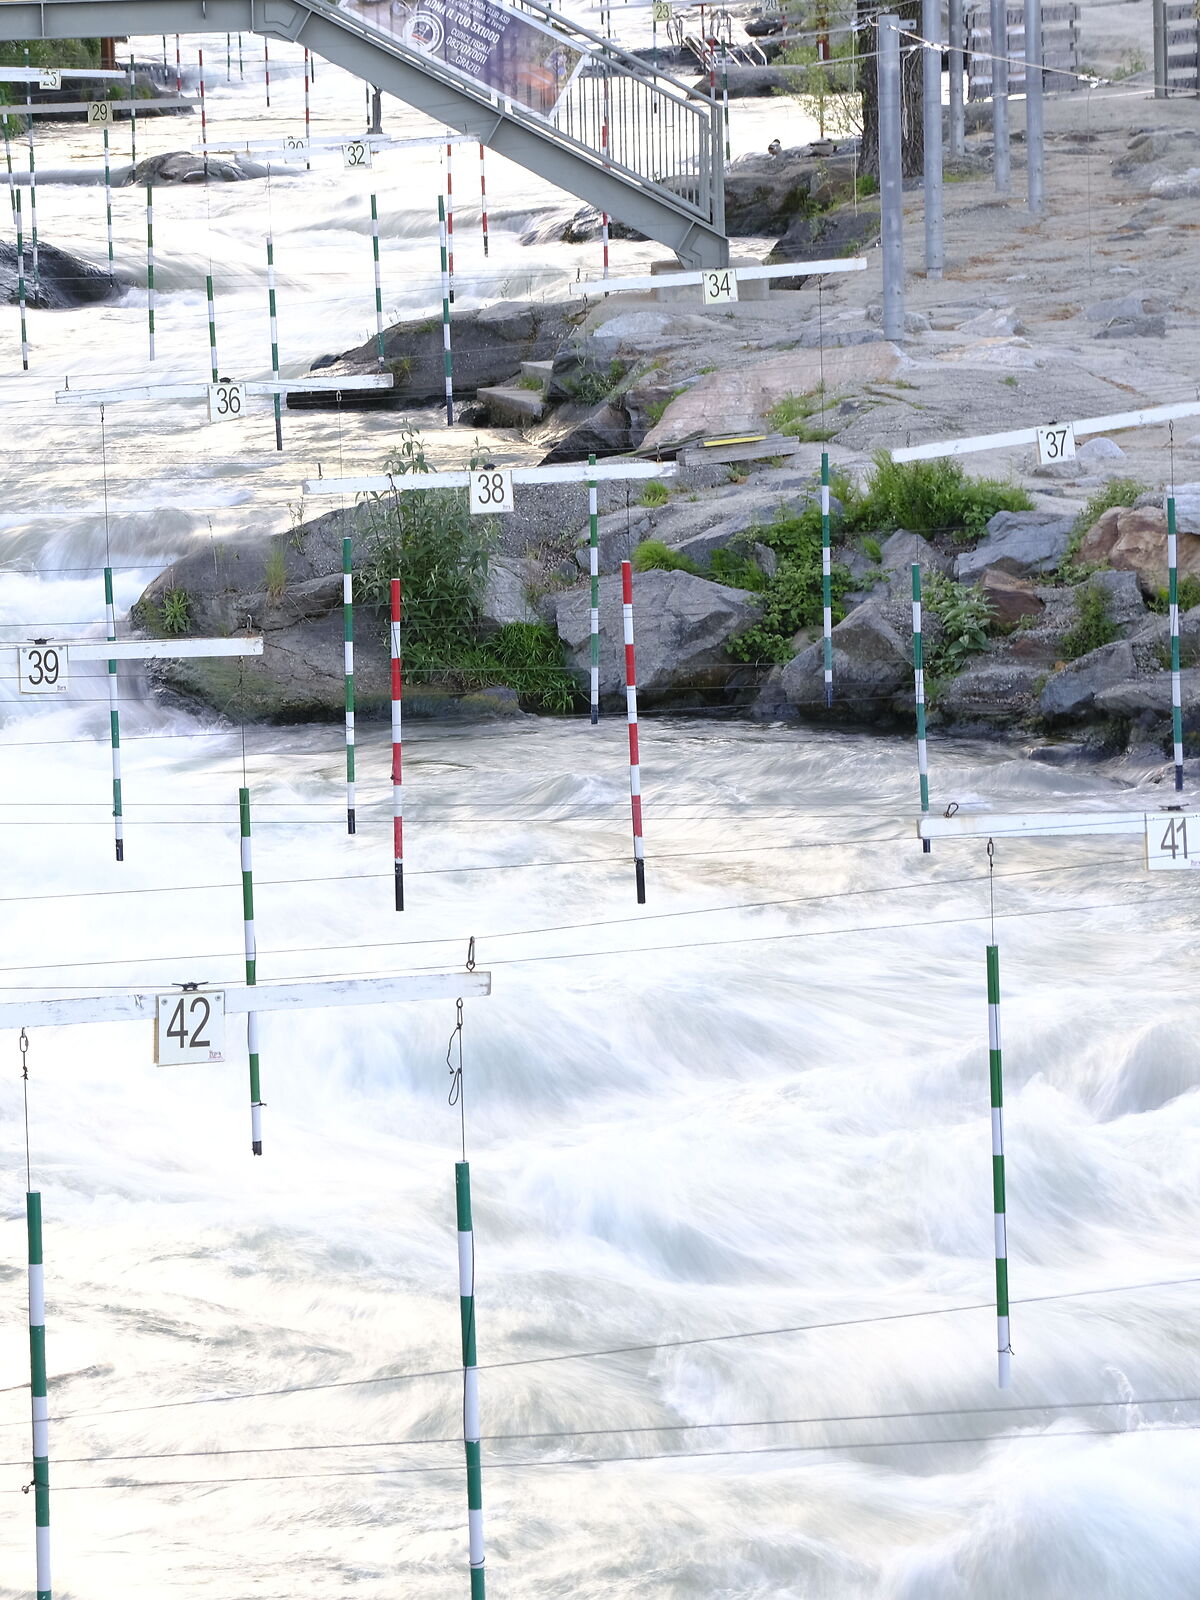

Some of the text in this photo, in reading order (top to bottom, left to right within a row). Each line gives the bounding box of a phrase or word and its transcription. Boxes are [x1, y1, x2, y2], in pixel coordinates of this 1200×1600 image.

[485, 6, 500, 19] CLUB
[499, 14, 510, 25] ASD
[656, 2, 670, 19] 23
[445, 8, 455, 20] IL
[454, 11, 472, 28] TUO
[470, 21, 500, 44] 5X1000
[445, 35, 488, 65] 08370770011
[450, 27, 472, 44] CODICE
[470, 38, 492, 56] FISCALE
[92, 104, 108, 121] 29
[347, 145, 366, 166] 32
[709, 272, 731, 298] 34
[216, 386, 241, 414] 36
[1046, 430, 1067, 458] 37
[478, 473, 505, 504] 38
[28, 649, 59, 685] 39
[1160, 817, 1188, 860] 41
[166, 996, 211, 1048] 42
